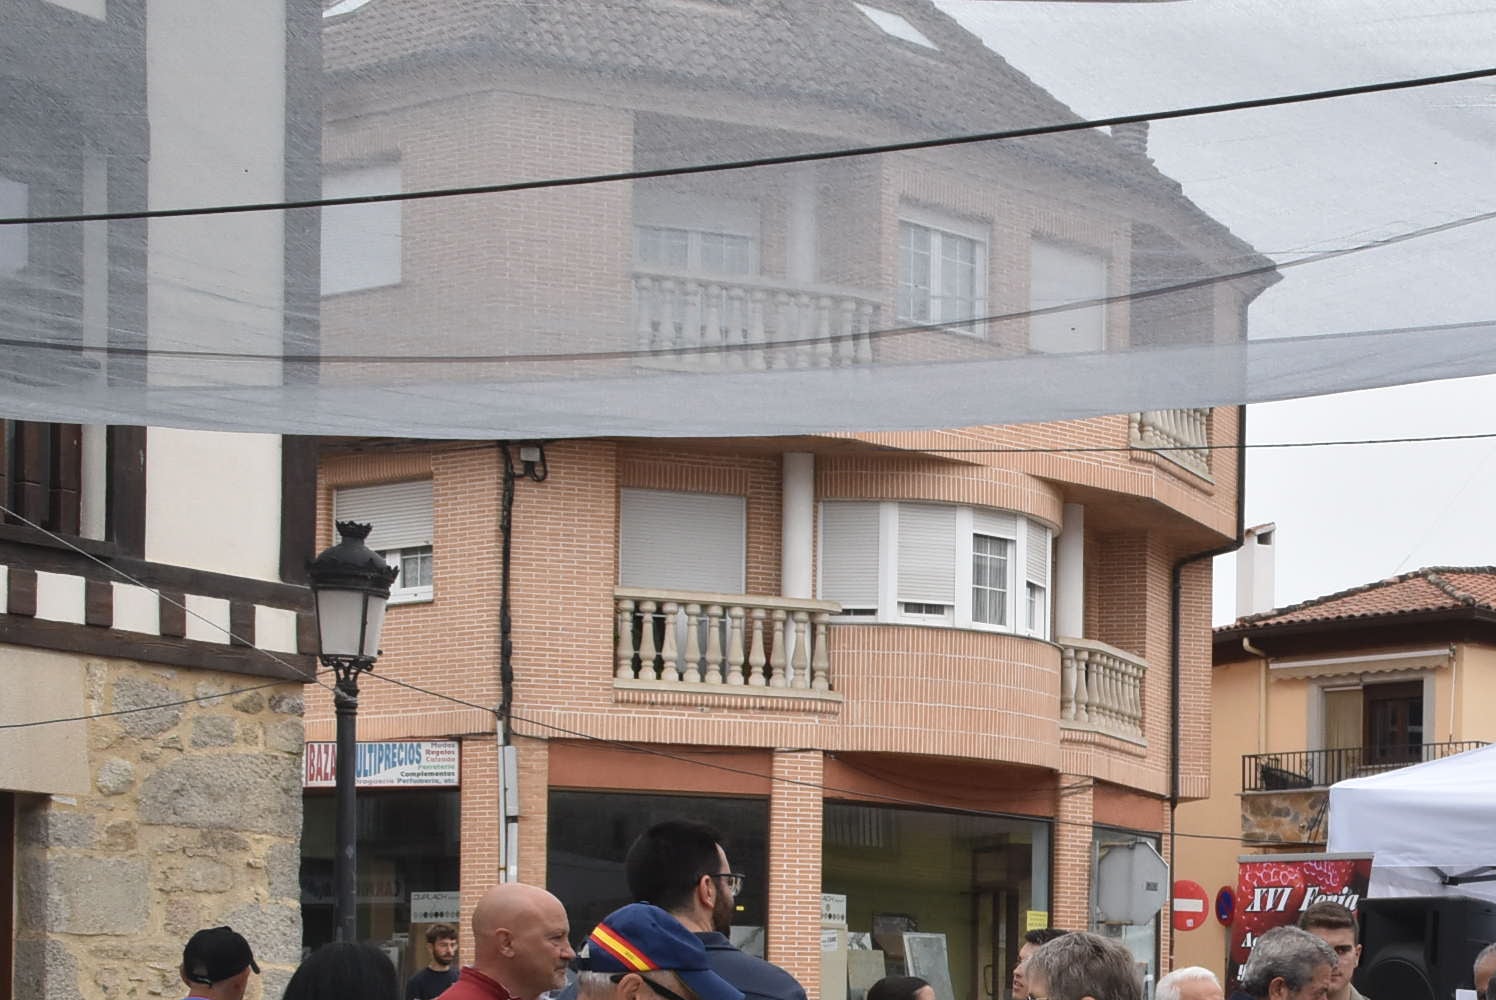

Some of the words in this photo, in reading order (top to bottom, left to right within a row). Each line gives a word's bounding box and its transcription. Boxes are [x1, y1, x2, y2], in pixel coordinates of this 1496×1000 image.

[308, 744, 336, 781] BAZA
[355, 743, 422, 778] ULTIPRECIOS
[425, 749, 455, 757] Regalos
[1245, 887, 1294, 912] XVI
